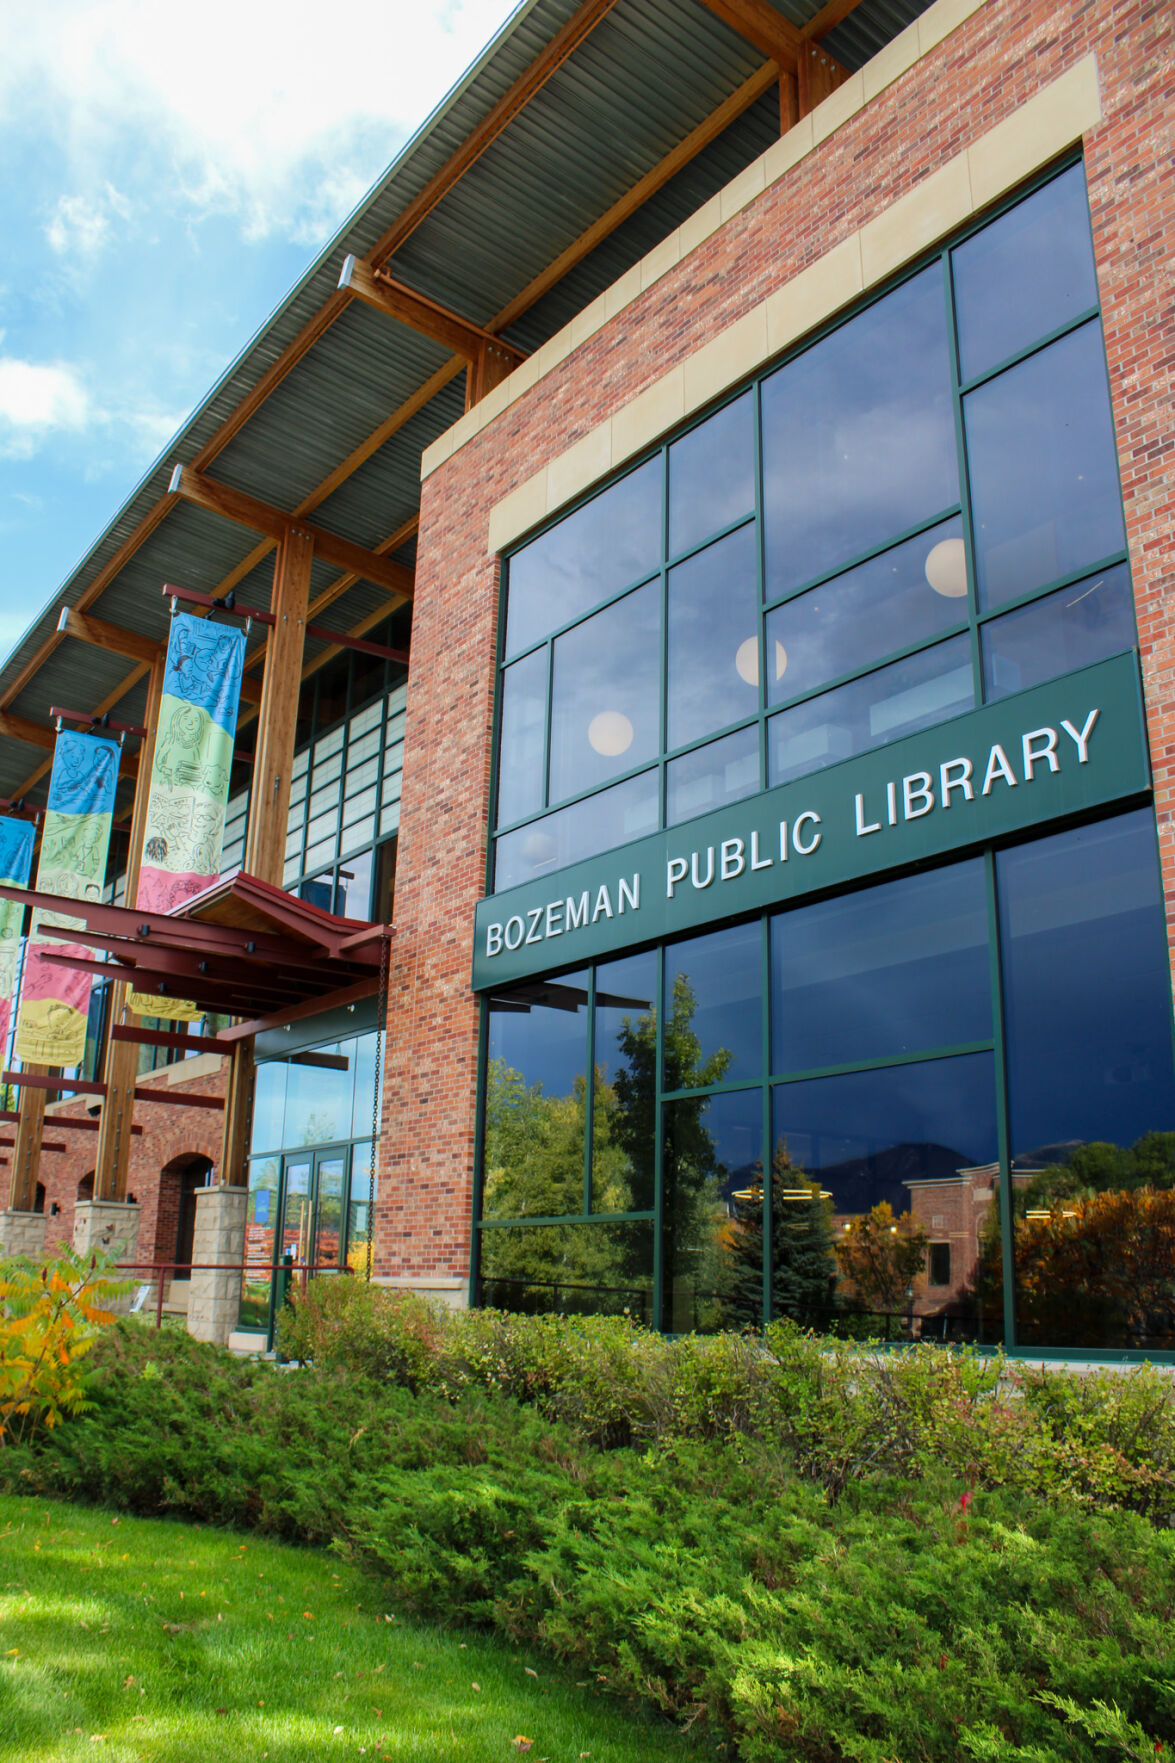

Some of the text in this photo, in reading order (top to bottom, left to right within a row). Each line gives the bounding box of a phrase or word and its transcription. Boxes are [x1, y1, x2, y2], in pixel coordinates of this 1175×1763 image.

[486, 708, 1099, 957] BOZEMAN PUBLIC LIBRARY
